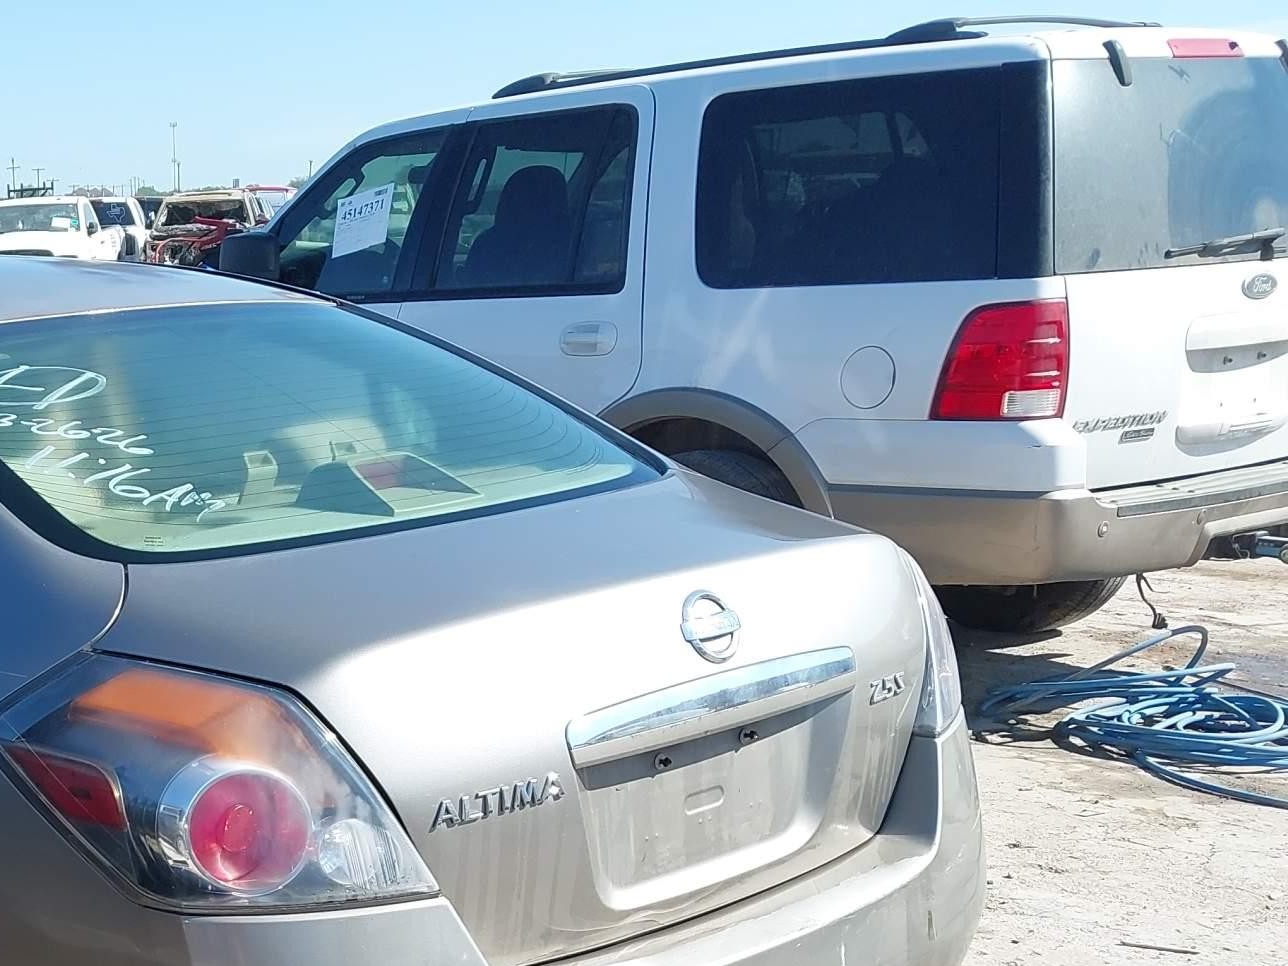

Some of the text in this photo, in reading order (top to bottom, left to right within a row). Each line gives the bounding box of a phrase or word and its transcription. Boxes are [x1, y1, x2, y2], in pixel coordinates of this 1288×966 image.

[341, 199, 385, 220] 45147371
[1073, 410, 1168, 434] EXPEDITION
[428, 771, 566, 833] ALTIMA
